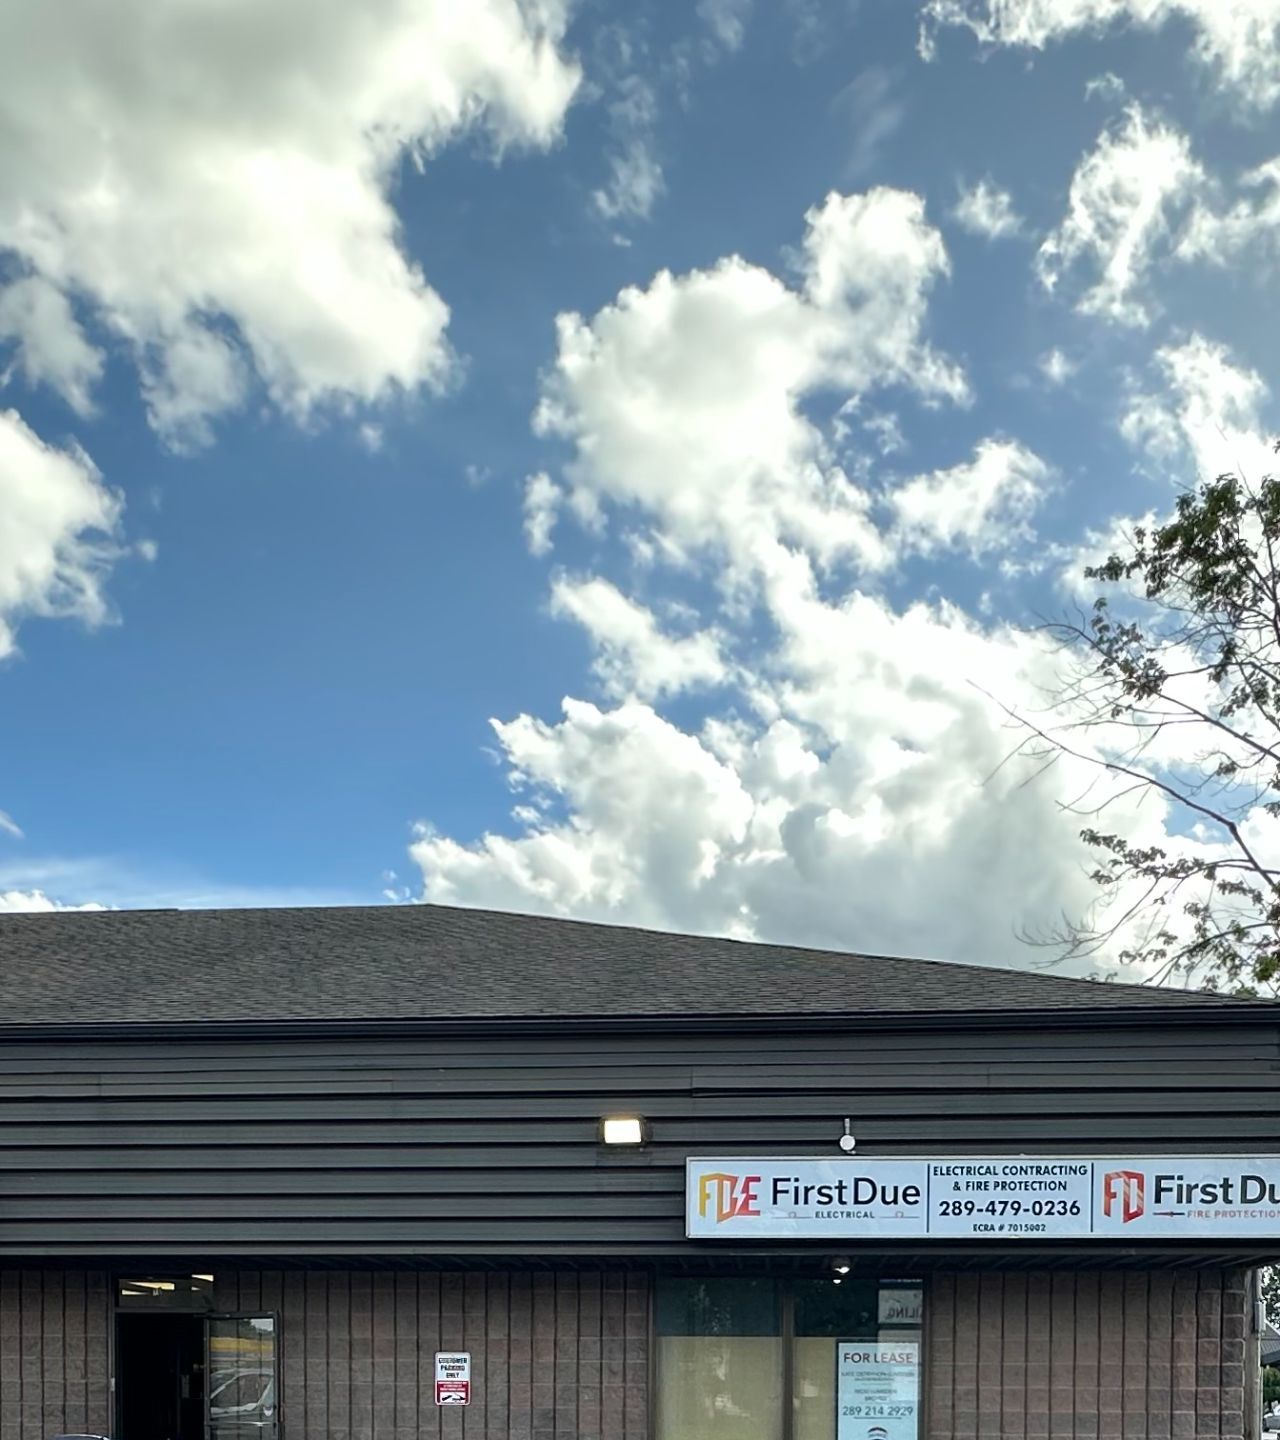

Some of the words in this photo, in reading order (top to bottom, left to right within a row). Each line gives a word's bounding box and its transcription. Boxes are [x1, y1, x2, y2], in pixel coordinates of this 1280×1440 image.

[933, 1165, 998, 1176] ELECTRICAL
[1002, 1165, 1088, 1176] CONTRACTING
[952, 1181, 961, 1191] &
[966, 1181, 990, 1191] FIRE
[993, 1180, 1067, 1191] PROTECTION
[1153, 1175, 1234, 1204] First
[772, 1177, 848, 1206] First
[853, 1177, 921, 1206] Due
[938, 1200, 1081, 1216] 289-479-0236
[815, 1211, 875, 1219] ELECTRICAL
[1187, 1210, 1210, 1218] FIRE
[973, 1224, 995, 1232] ECRA
[998, 1224, 1005, 1232] #
[843, 1353, 870, 1363] FOR
[874, 1352, 914, 1363] LEASE
[842, 1406, 861, 1416] 289
[864, 1406, 884, 1416] 214
[887, 1406, 913, 1416] 2929
